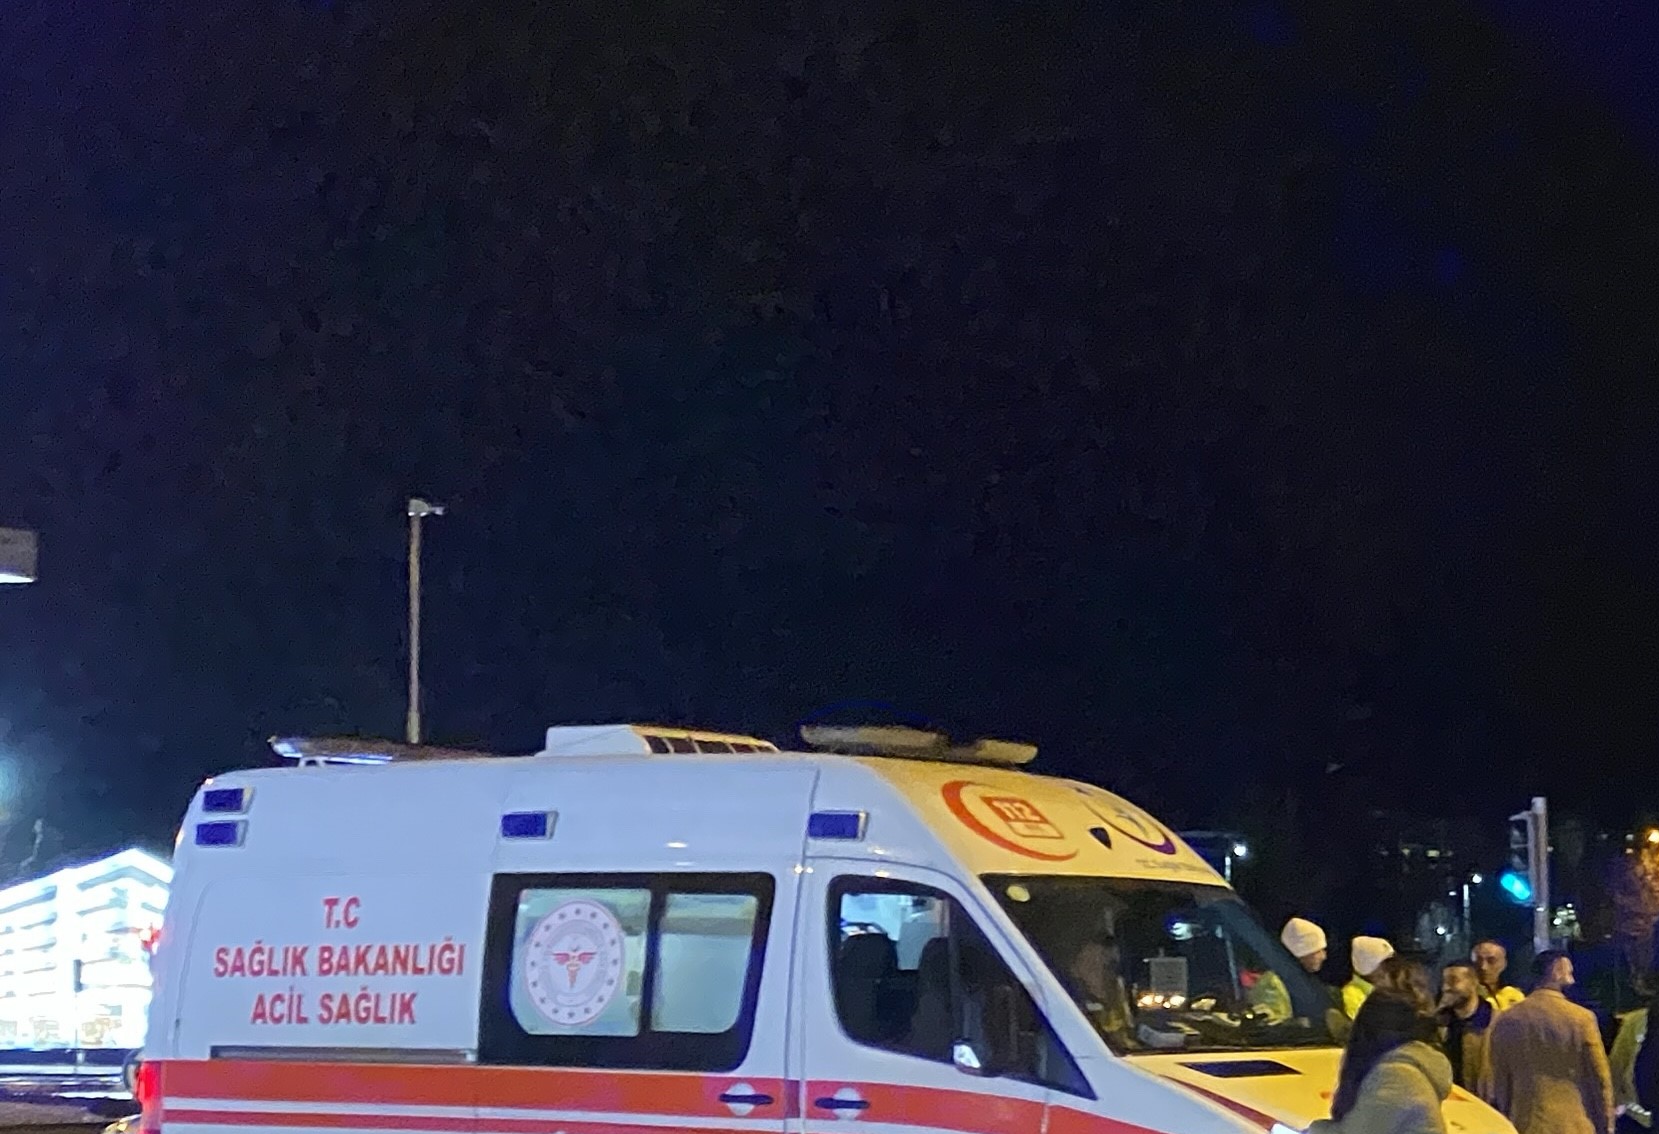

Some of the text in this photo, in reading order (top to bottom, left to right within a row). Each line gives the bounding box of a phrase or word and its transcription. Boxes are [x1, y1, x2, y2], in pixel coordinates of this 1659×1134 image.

[323, 896, 361, 929] T.C
[214, 936, 466, 977] SAĞLIK BAKANLIĞI
[250, 985, 417, 1025] ACİL SAĞLIK
